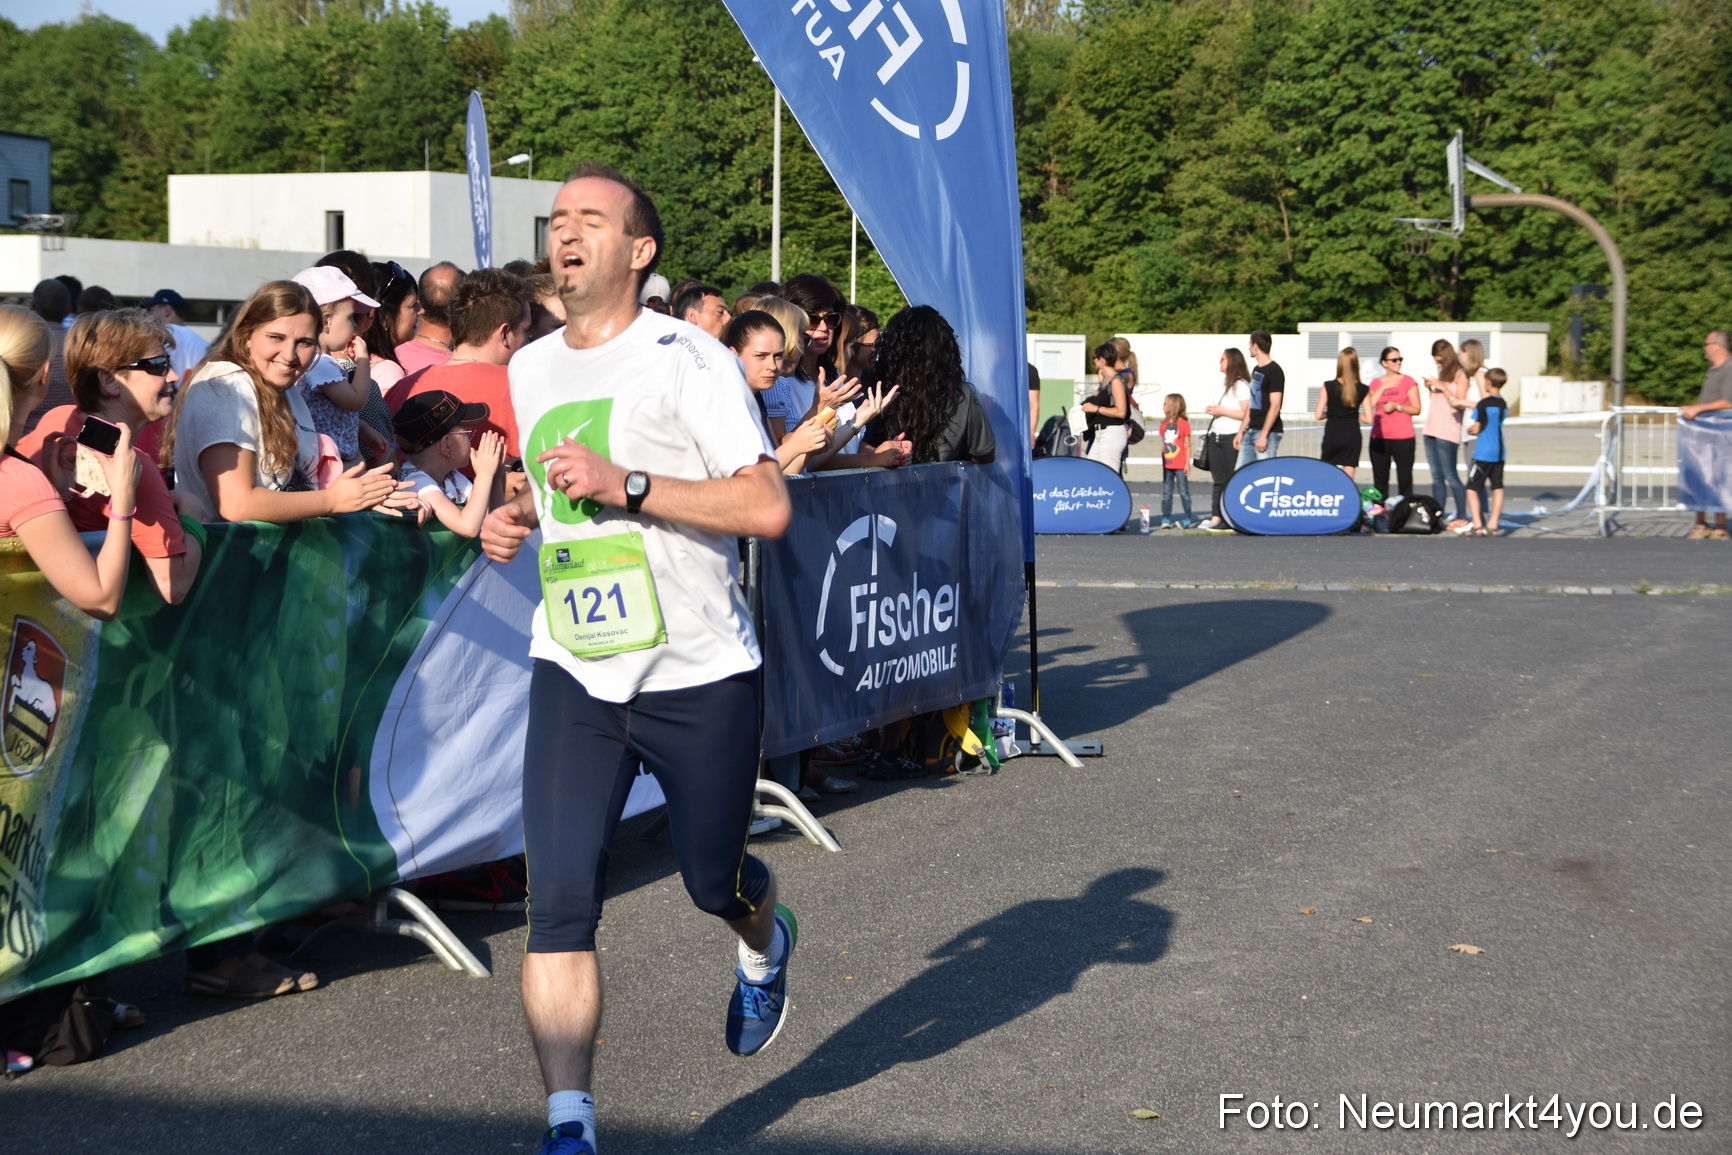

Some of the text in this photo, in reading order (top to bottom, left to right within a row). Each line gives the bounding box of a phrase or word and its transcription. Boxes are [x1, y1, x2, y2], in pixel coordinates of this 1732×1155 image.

[1049, 486, 1070, 499] das
[1259, 490, 1345, 509] Fischer
[1268, 508, 1339, 518] AUTOMOBILE
[563, 582, 627, 625] 121
[575, 628, 629, 641] Denijal Kosovac
[855, 643, 958, 692] AUTOMOBILE
[9, 733, 38, 766] 1628
